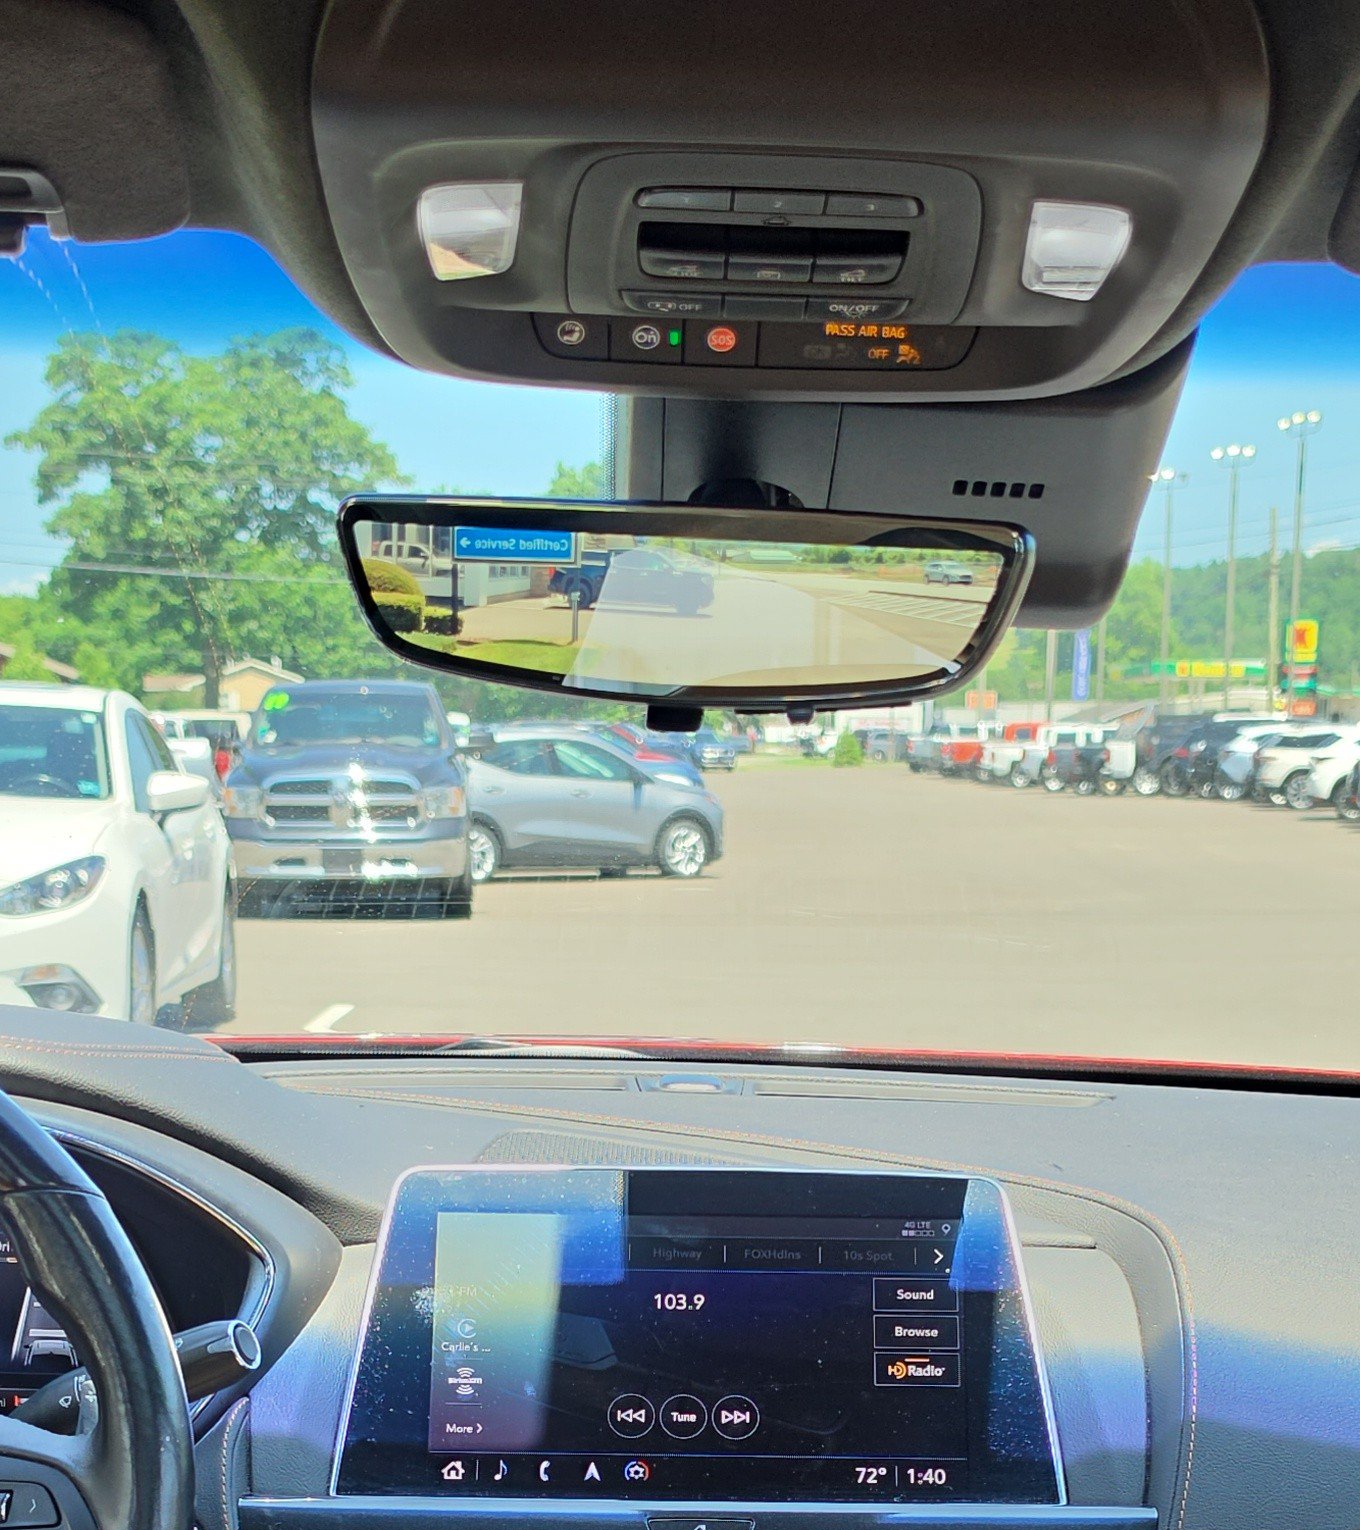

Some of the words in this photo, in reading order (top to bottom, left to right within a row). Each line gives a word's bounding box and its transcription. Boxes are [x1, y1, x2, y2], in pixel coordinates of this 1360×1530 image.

[678, 303, 703, 311] OFF
[829, 303, 880, 313] ON/OFF
[825, 322, 855, 336] PASS
[858, 324, 878, 338] AIR
[882, 326, 906, 339] BAG
[711, 334, 732, 346] SOS
[868, 348, 889, 360] OFF
[904, 1221, 916, 1229] 4G
[917, 1221, 931, 1229] LTE
[653, 1247, 702, 1261] Highway
[843, 1250, 863, 1261] 10s
[460, 1286, 477, 1297] FM
[896, 1289, 934, 1301] Sound
[653, 1293, 706, 1311] 103.9
[894, 1326, 939, 1338] Browse
[907, 1364, 945, 1377] Radio
[671, 1411, 697, 1423] Tune
[446, 1423, 474, 1434] More
[854, 1466, 888, 1484] 72°
[906, 1468, 947, 1485] 1:40
